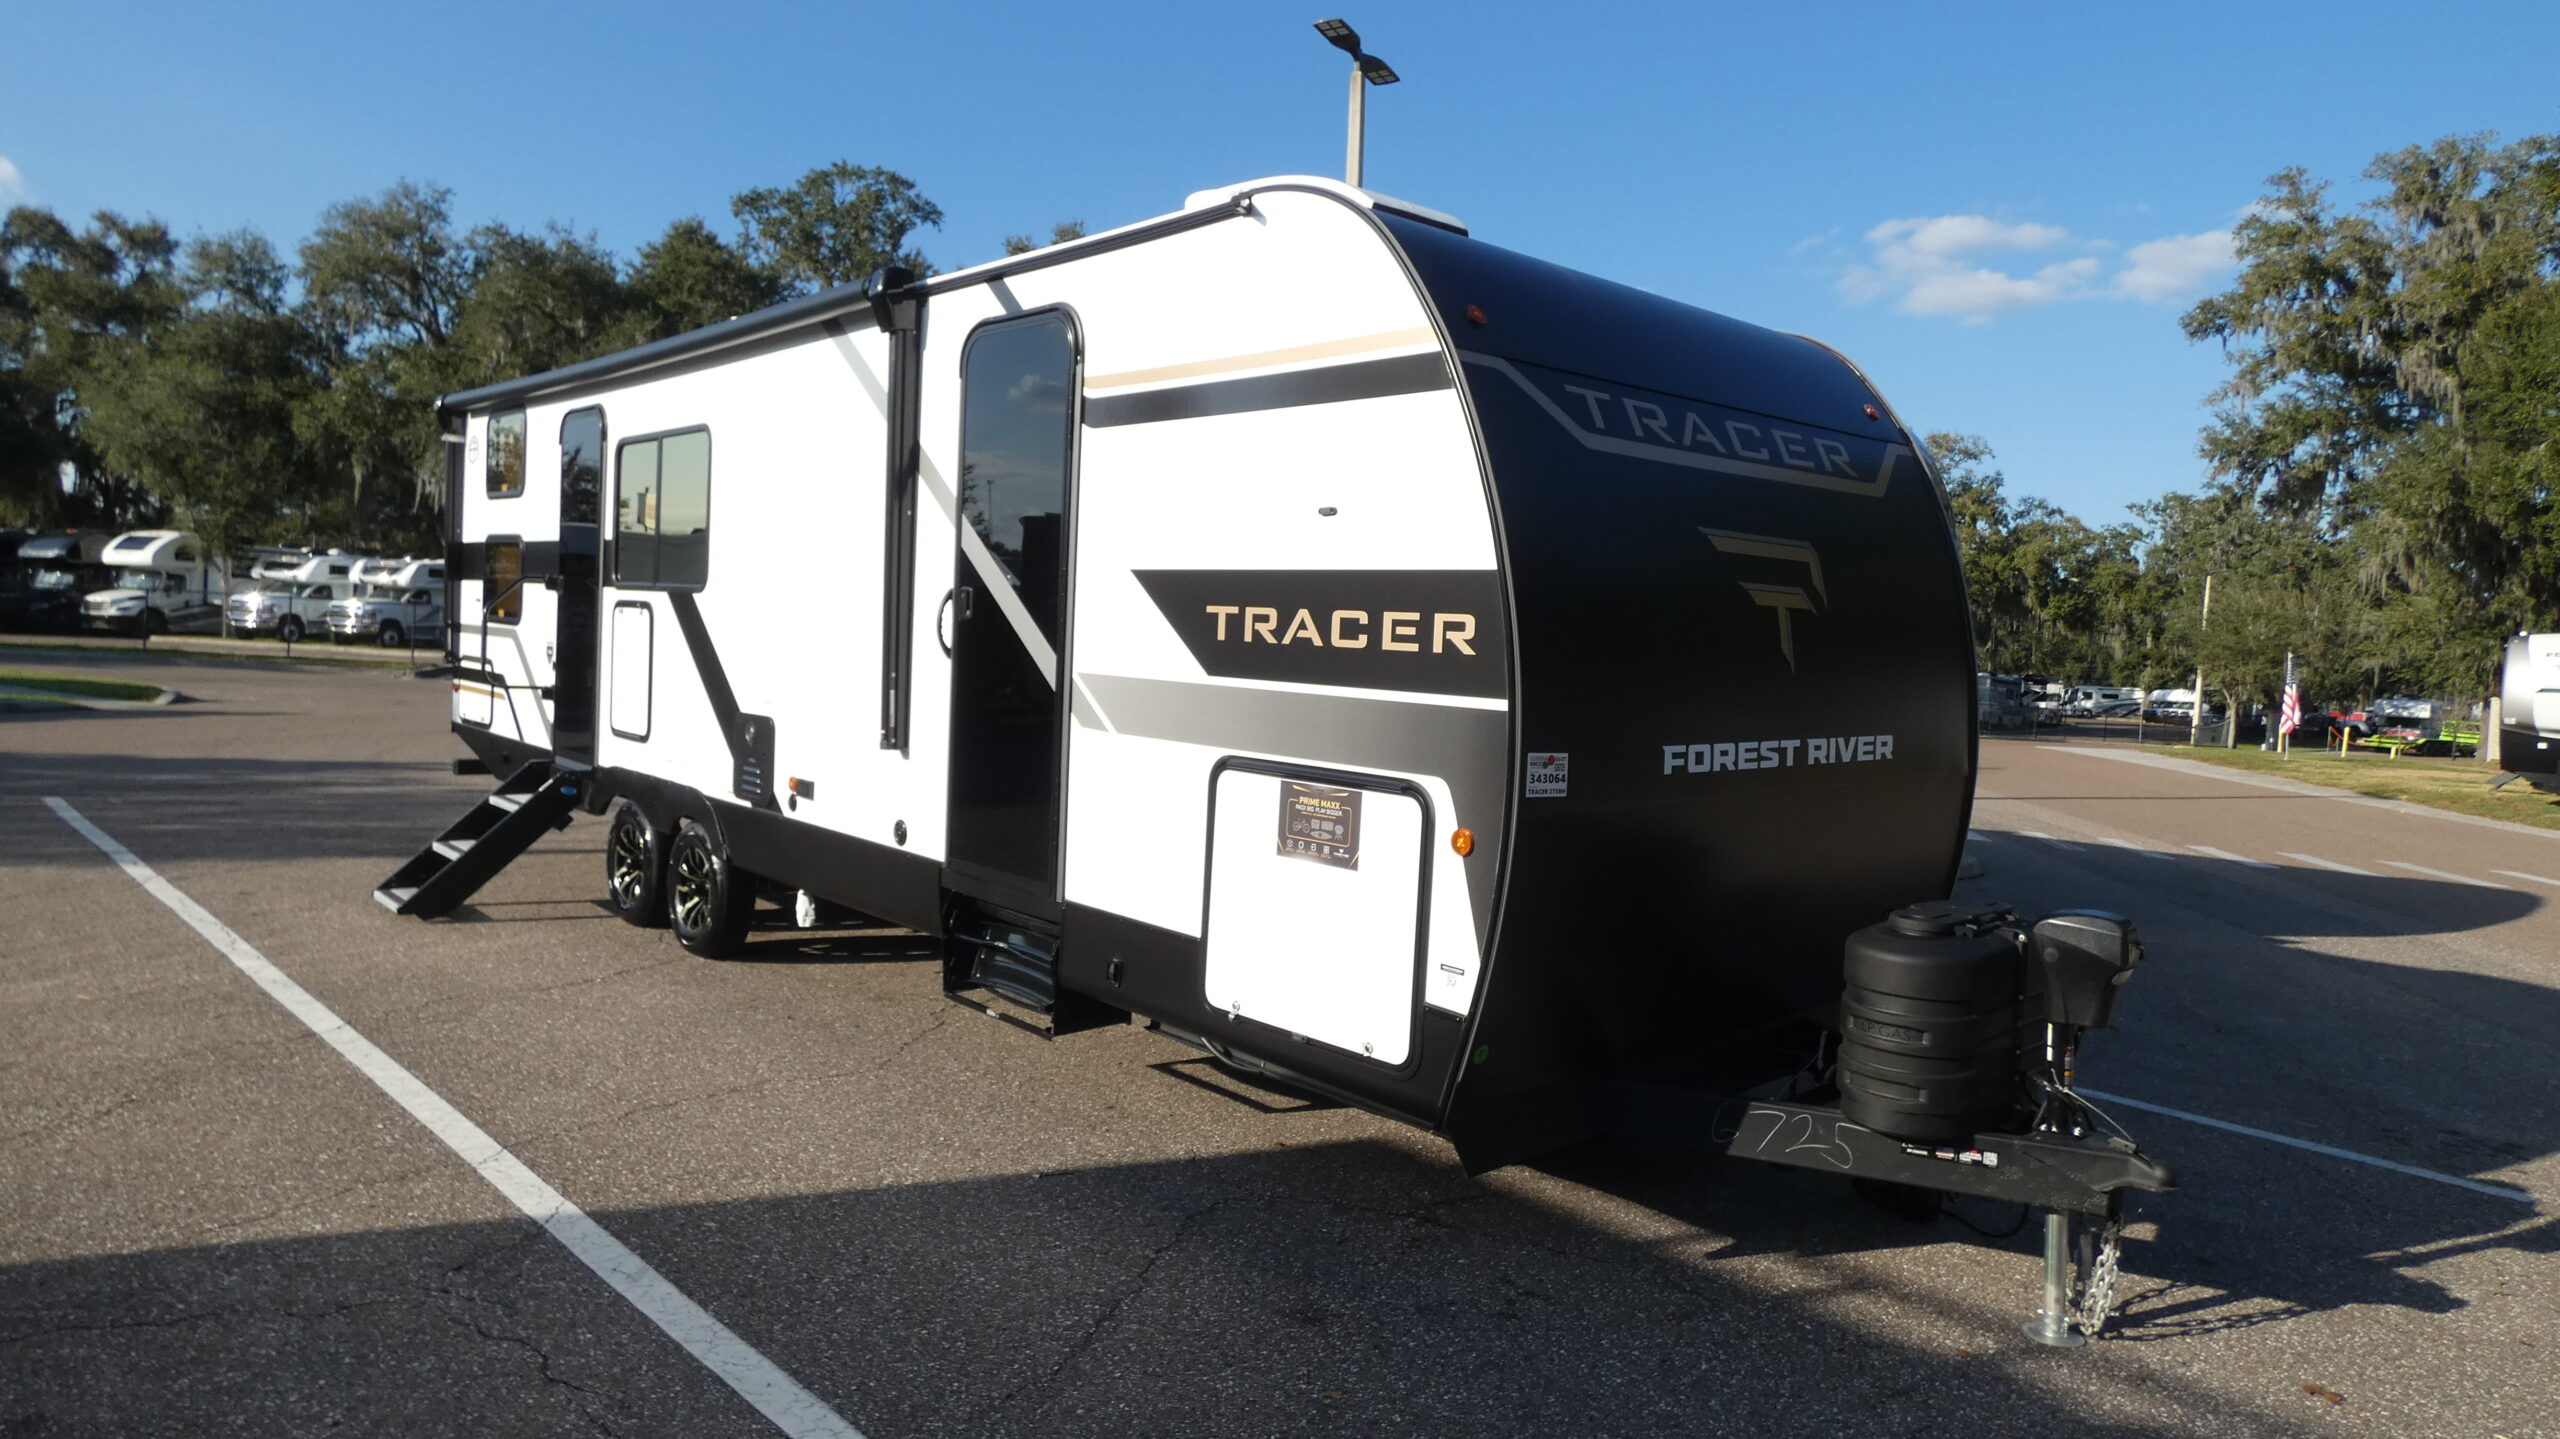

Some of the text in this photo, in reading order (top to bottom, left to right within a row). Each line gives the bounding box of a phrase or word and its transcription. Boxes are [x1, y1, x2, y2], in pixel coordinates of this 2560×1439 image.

[1564, 384, 1857, 477] TRACER
[1206, 605, 1476, 655] TRACER
[1663, 735, 1894, 775] FOREST RIVER
[1530, 773, 1567, 784] 343064
[1299, 796, 1341, 810] PRIME MAXX
[1878, 1024, 1911, 1042] GAS
